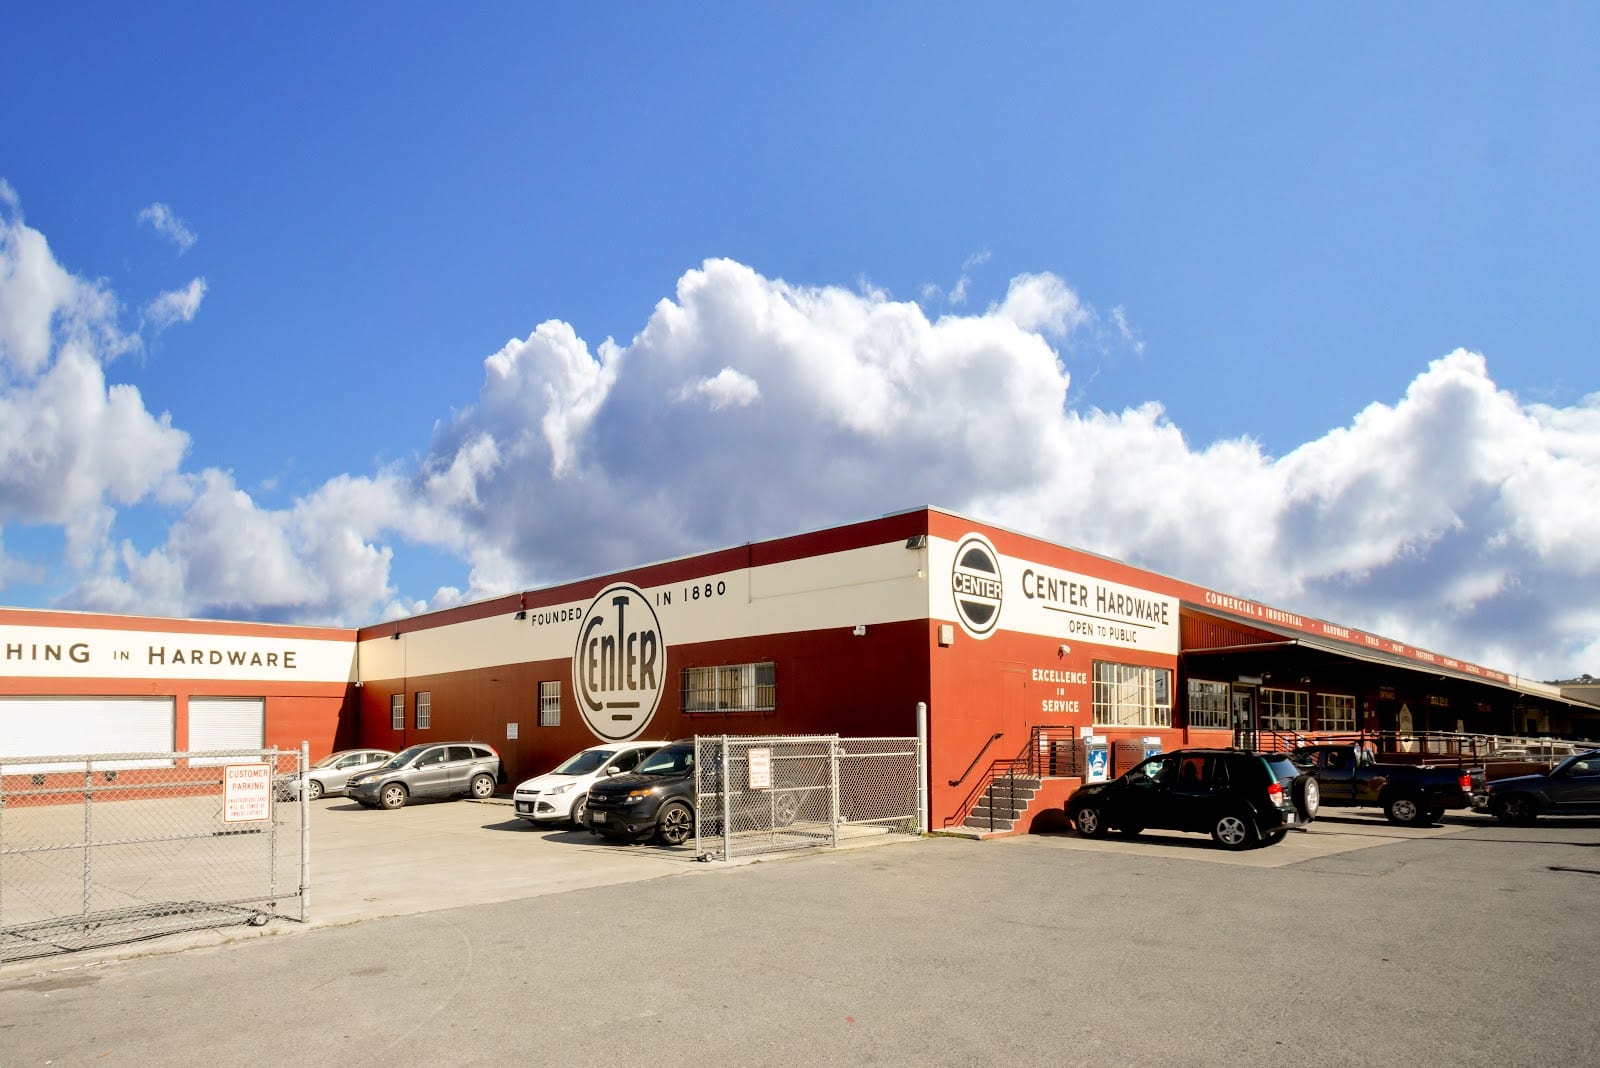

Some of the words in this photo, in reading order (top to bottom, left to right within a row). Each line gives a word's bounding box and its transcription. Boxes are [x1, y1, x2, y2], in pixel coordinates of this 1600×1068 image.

[953, 572, 1002, 600] CENTER
[1021, 568, 1089, 608] CENTER
[1096, 585, 1170, 626] HARDWARE
[531, 607, 582, 627] FOUNDED
[656, 592, 672, 606] IN
[684, 581, 726, 601] 1880
[1205, 591, 1255, 615] COMMERCIAL
[1265, 608, 1303, 627] INDUSTRIAL
[1069, 620, 1094, 636] OPEN
[1097, 626, 1107, 637] TO
[1109, 627, 1138, 643] PUBLIC
[6, 643, 90, 663] HING
[113, 650, 129, 660] IN
[148, 646, 297, 669] HARDWARE
[1032, 668, 1087, 685] EXCELLENCE
[1056, 687, 1065, 696] IN
[1042, 700, 1080, 713] SERVICE
[229, 769, 268, 779] CUSTOMER
[232, 782, 265, 791] PARKING
